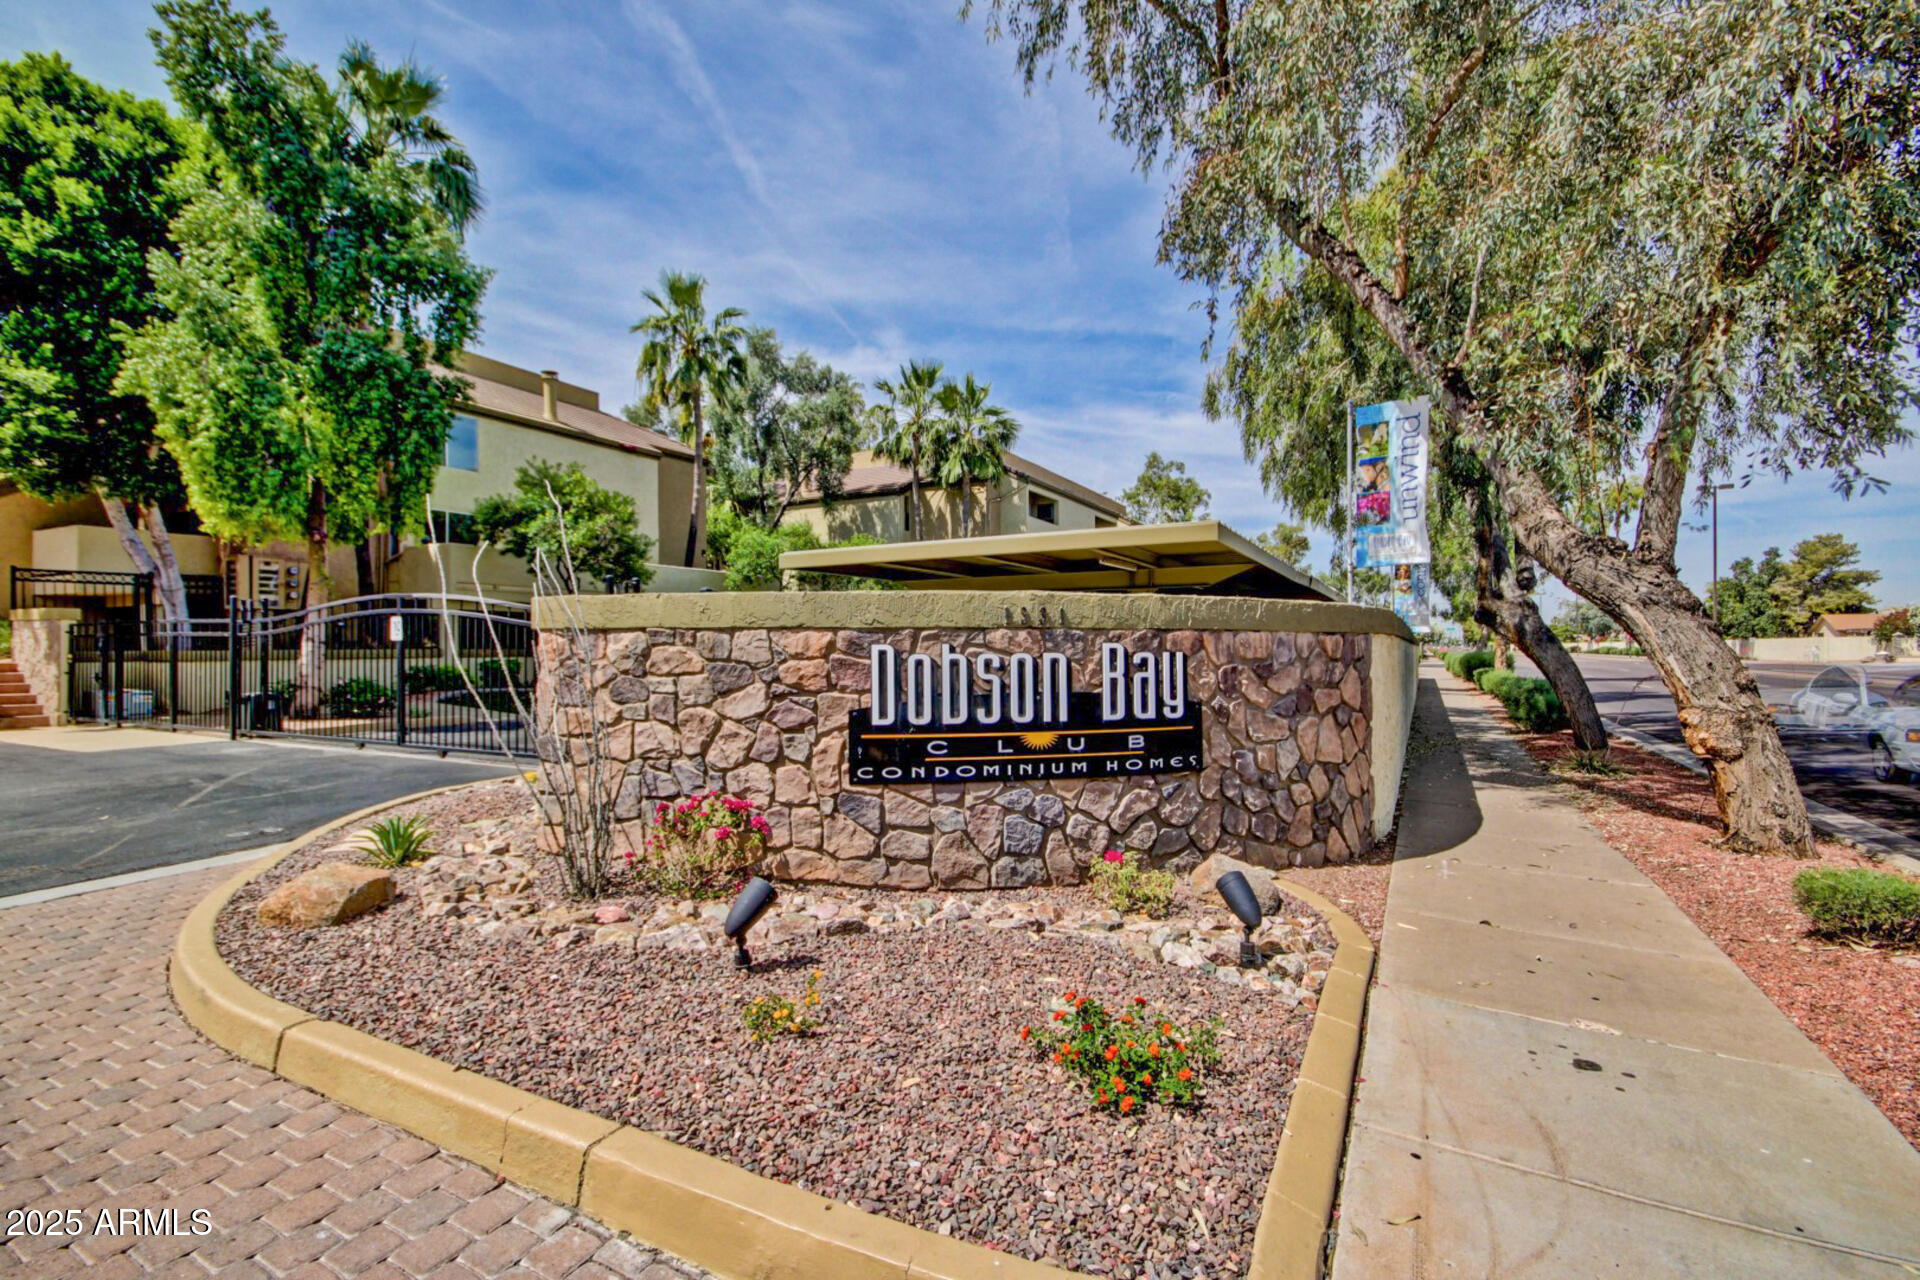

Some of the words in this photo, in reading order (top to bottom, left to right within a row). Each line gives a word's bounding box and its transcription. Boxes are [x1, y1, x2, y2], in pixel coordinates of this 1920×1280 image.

[1394, 412, 1421, 522] unwind
[871, 643, 1069, 726] Dobson
[1102, 642, 1185, 721] Bay
[857, 761, 1088, 779] CONDOMINIUM
[1107, 755, 1198, 772] HOMES
